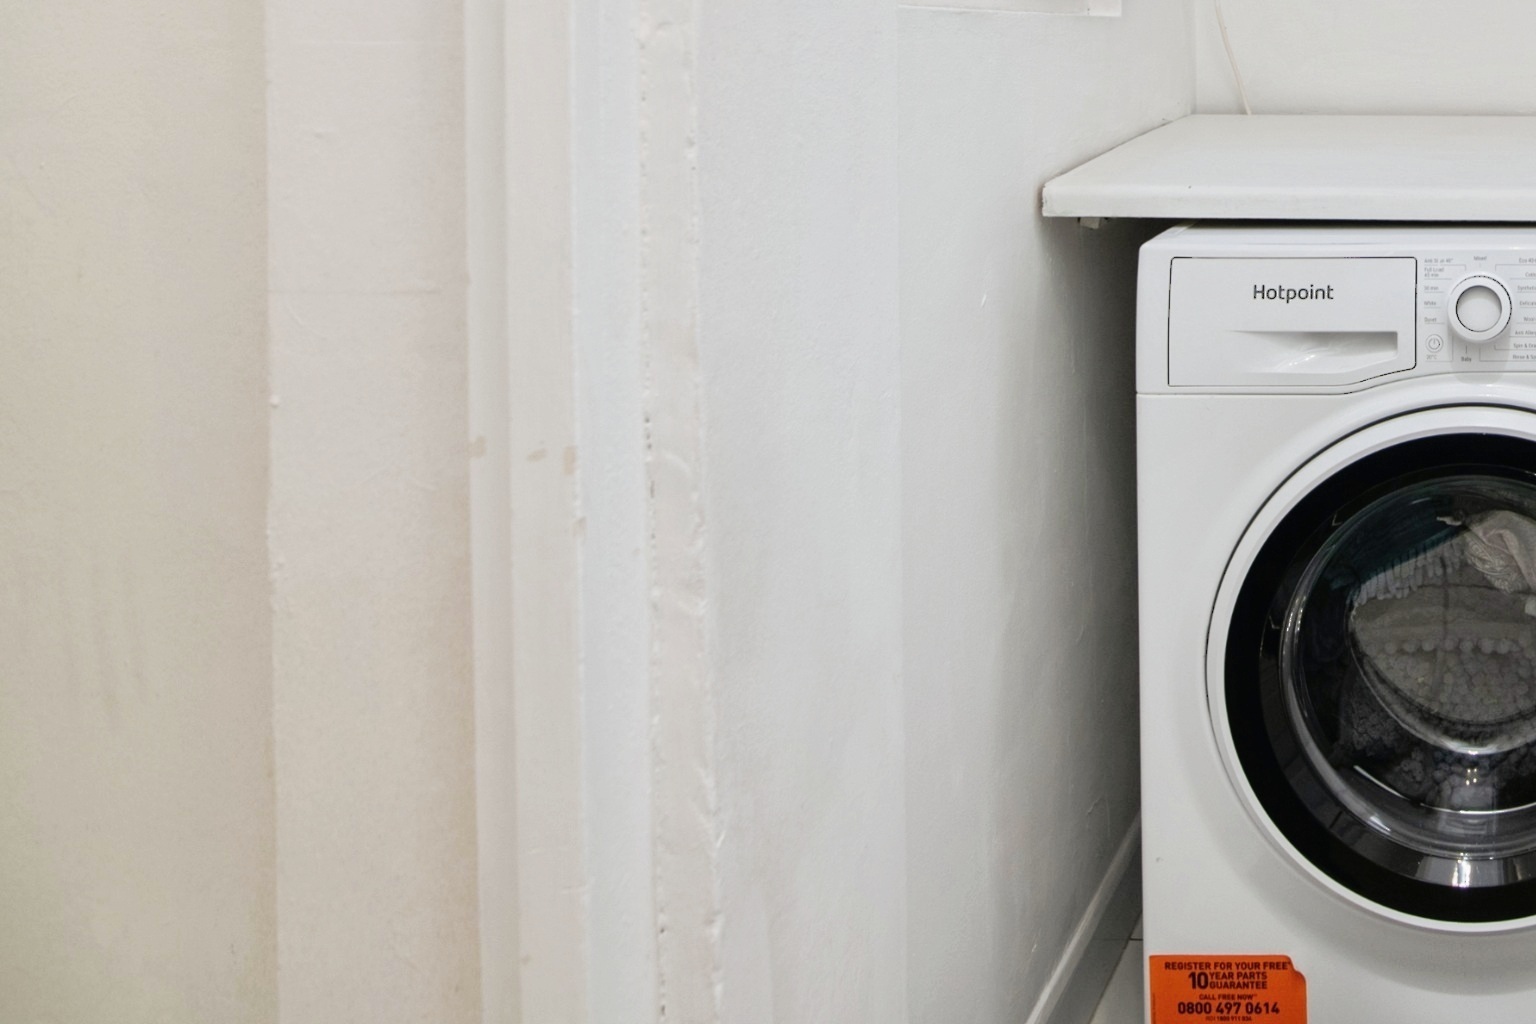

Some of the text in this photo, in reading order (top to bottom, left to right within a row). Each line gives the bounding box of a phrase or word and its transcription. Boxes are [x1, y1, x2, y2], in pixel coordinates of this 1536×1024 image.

[1253, 284, 1334, 304] Hotpoint
[1164, 961, 1211, 971] REGISTER
[1213, 961, 1233, 971] FOR
[1235, 961, 1261, 971] YOUR
[1188, 971, 1268, 990] 10 YEAR PARTS
[1209, 980, 1268, 990] GUARANTEE
[1177, 1002, 1280, 1015] 0800 497 0614
